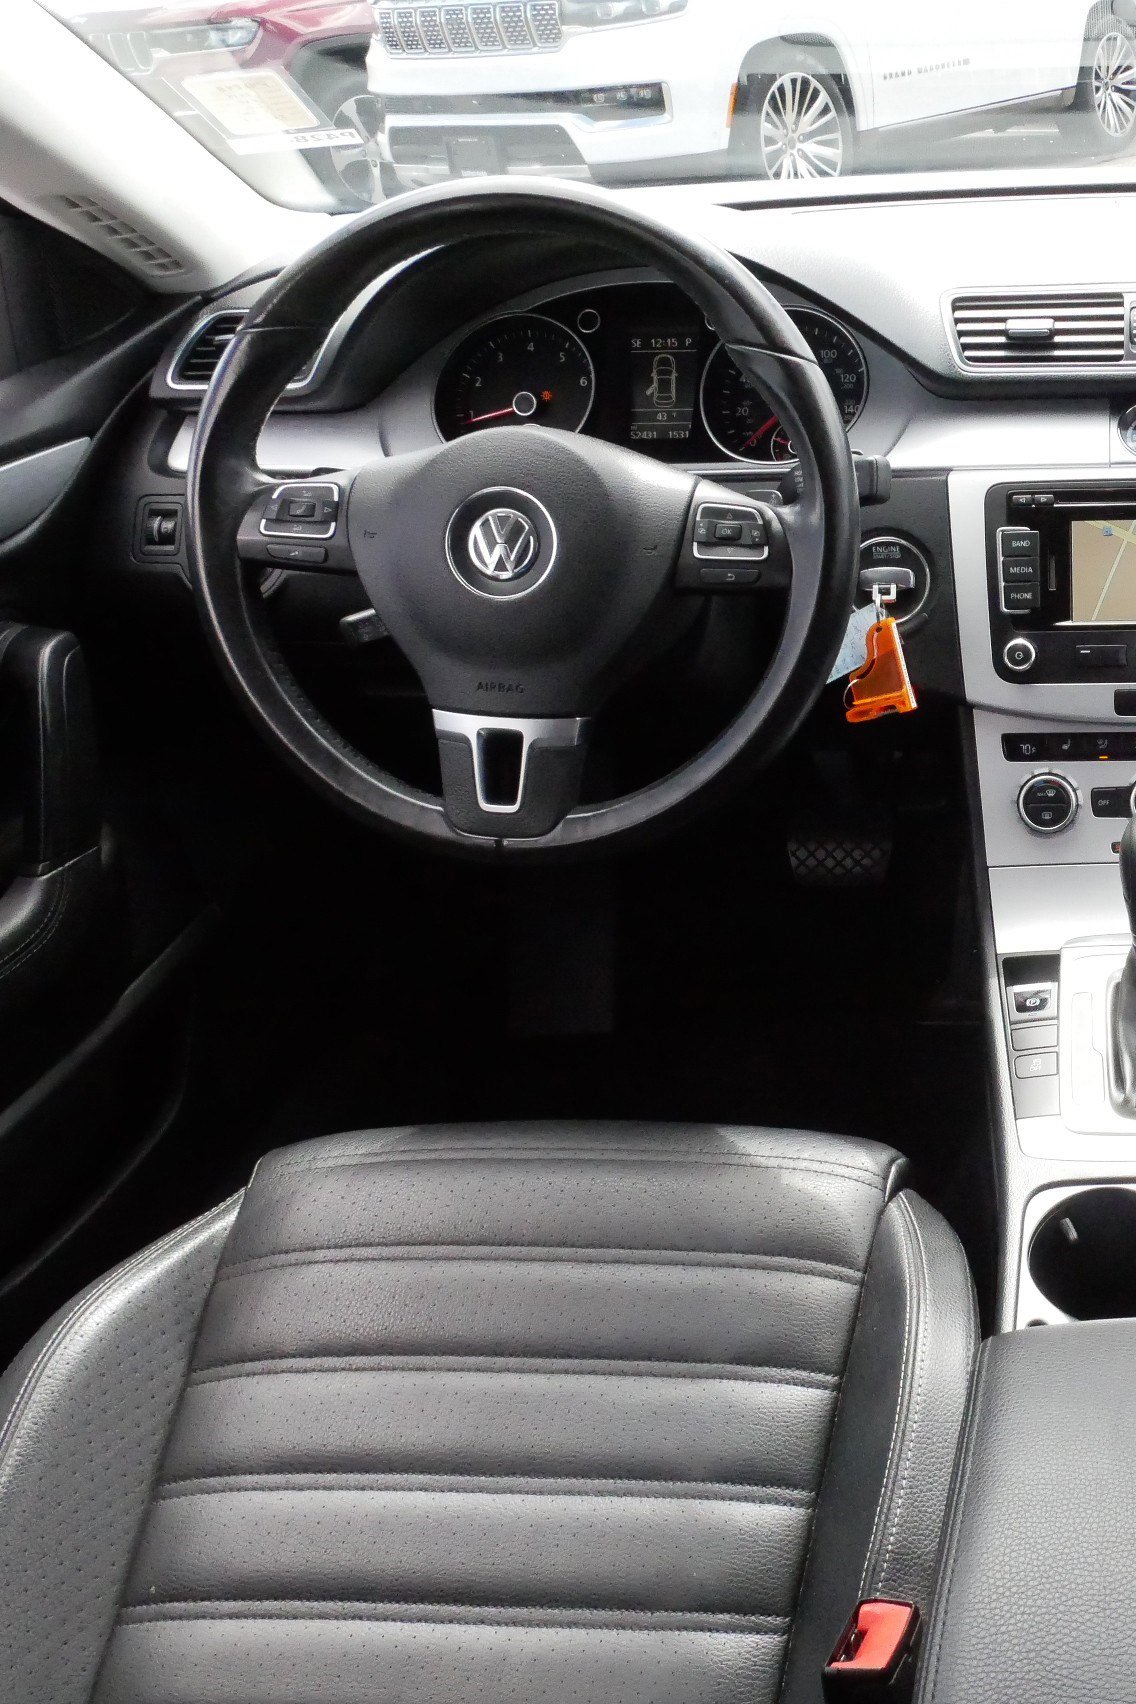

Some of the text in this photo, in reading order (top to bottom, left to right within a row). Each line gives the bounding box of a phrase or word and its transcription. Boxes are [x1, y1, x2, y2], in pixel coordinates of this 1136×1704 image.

[527, 342, 535, 352] 4
[650, 337, 678, 348] 12:15
[685, 337, 692, 347] P
[498, 352, 504, 362] 3
[560, 352, 566, 362] 5
[820, 350, 838, 359] 100
[475, 376, 482, 387] 2
[580, 376, 588, 387] 6
[840, 373, 857, 383] 120
[656, 412, 668, 421] 43
[735, 406, 750, 417] 20
[872, 545, 900, 553] ENGINE
[1011, 540, 1031, 548] BAND
[1009, 566, 1033, 574] MEDIA
[1010, 592, 1033, 600] PHONE
[476, 682, 525, 694] AIRBAG
[1097, 799, 1110, 807] OFF
